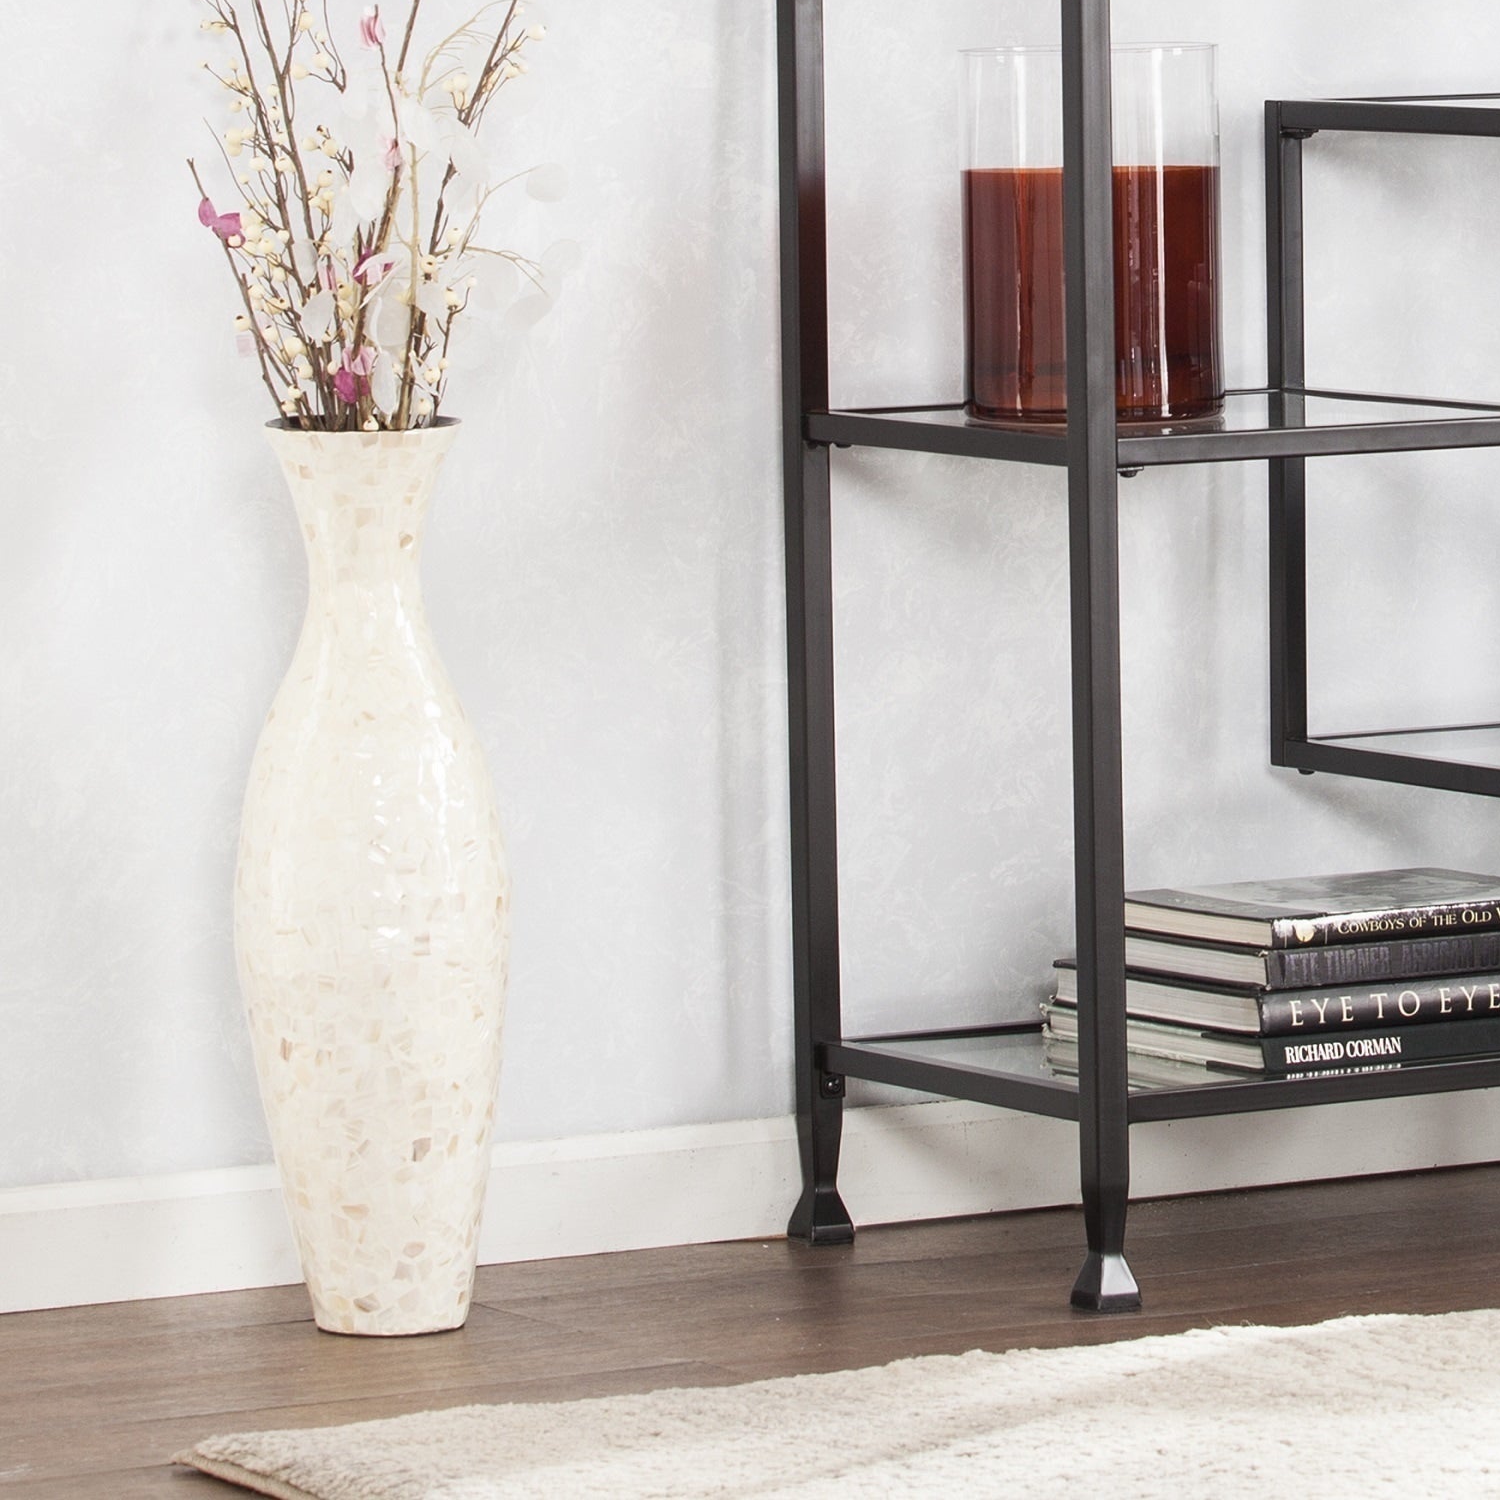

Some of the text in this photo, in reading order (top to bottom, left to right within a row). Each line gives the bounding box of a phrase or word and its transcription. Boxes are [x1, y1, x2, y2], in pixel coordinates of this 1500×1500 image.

[1337, 917, 1405, 935] COWBOYS
[1409, 916, 1427, 929] OF
[1431, 913, 1458, 927] THE
[1461, 909, 1492, 924] OLD
[1289, 995, 1355, 1027] EYE
[1370, 990, 1421, 1019] TO
[1284, 1041, 1345, 1064] RICHARD
[1346, 1036, 1402, 1058] CORMAN
